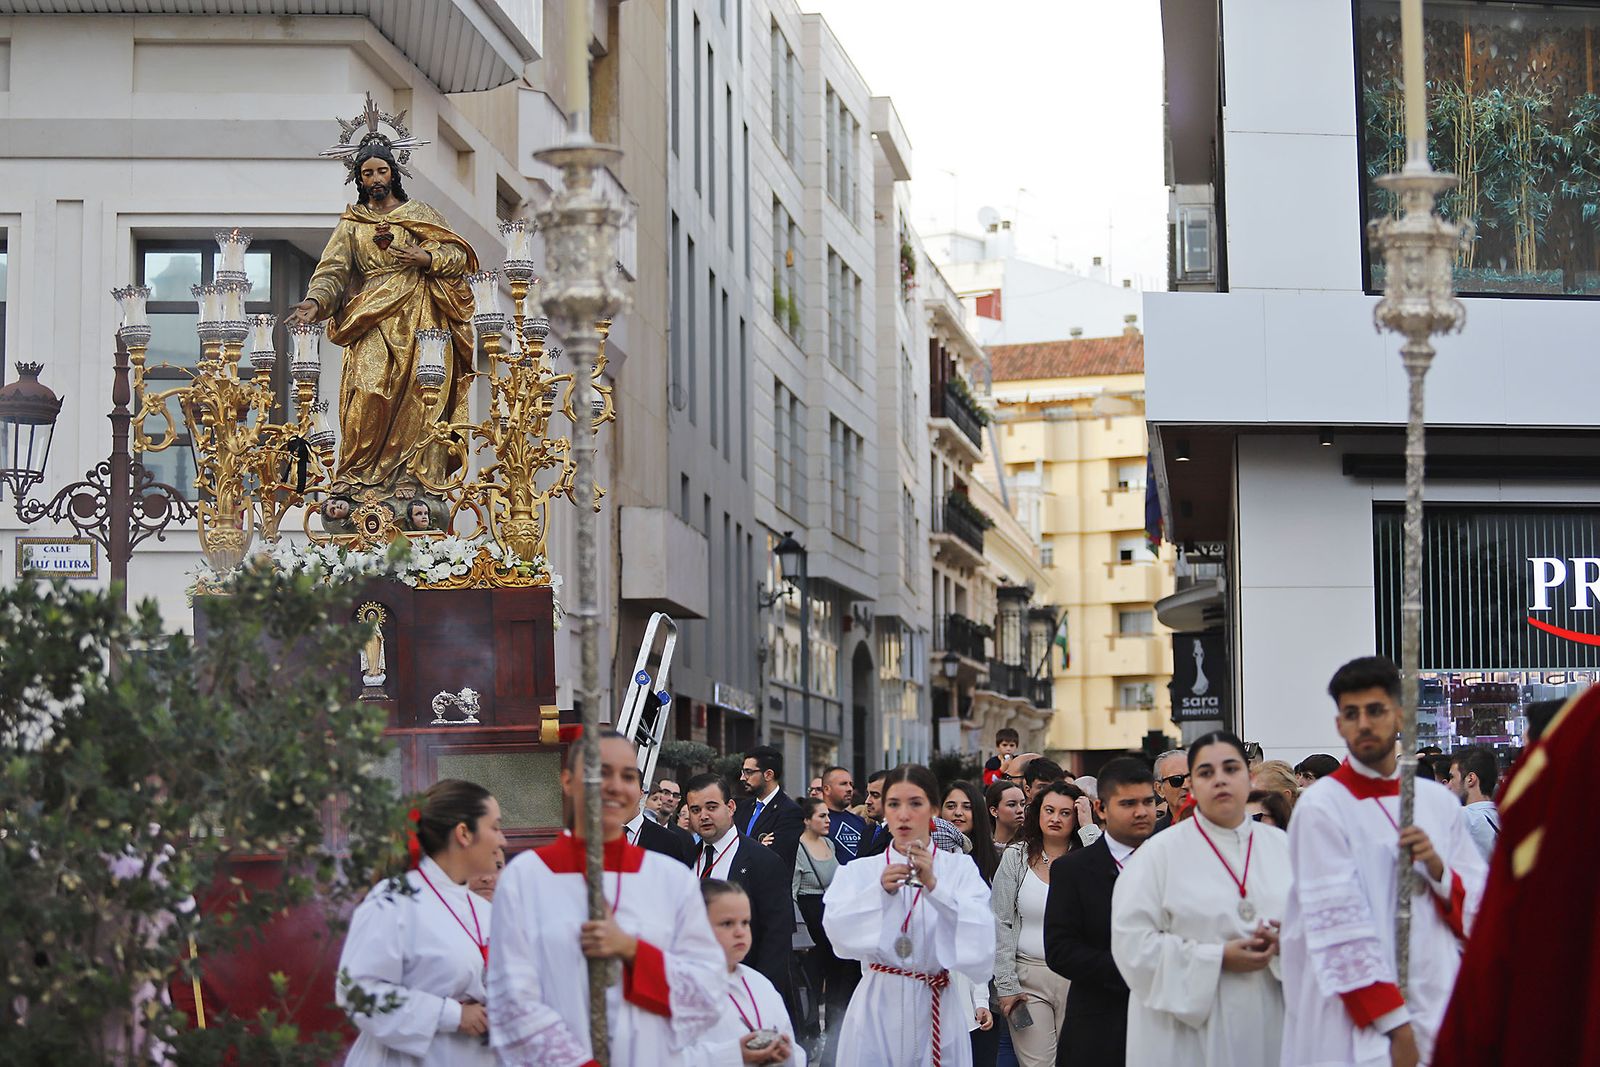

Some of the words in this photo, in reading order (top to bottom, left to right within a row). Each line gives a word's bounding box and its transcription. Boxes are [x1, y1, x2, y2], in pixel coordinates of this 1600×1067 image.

[54, 559, 90, 569] ULTRA
[1527, 557, 1600, 611] PR
[1182, 697, 1219, 707] sara
[1182, 707, 1219, 716] merino
